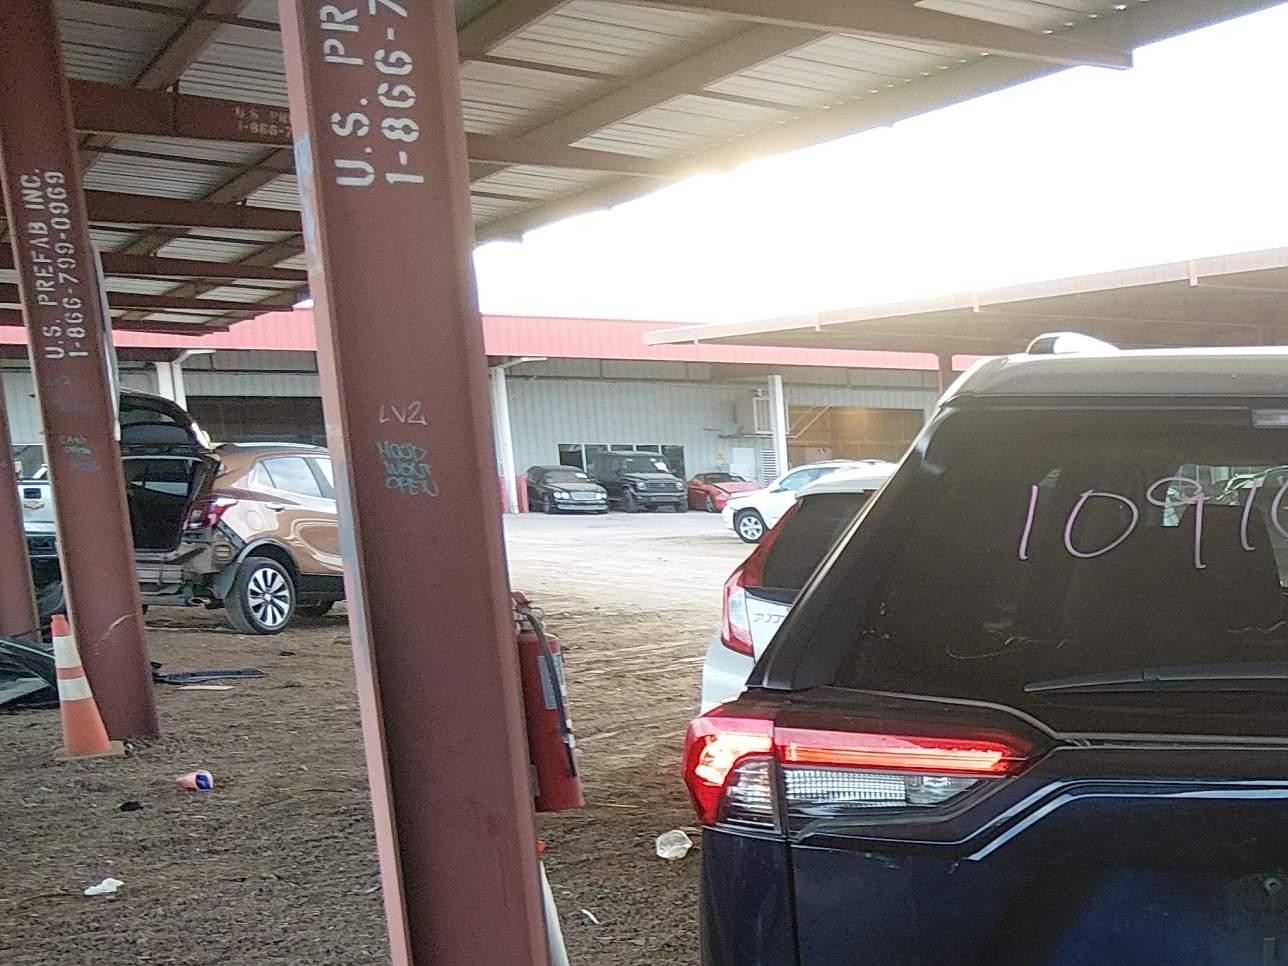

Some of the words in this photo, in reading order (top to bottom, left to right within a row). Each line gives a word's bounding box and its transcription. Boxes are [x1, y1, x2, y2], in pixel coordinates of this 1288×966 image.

[332, 97, 376, 187] U.S.
[20, 168, 46, 211] INC.
[28, 220, 58, 307] PREFAB
[44, 171, 89, 357] 1-866-799-0969
[42, 319, 65, 360] U.S.
